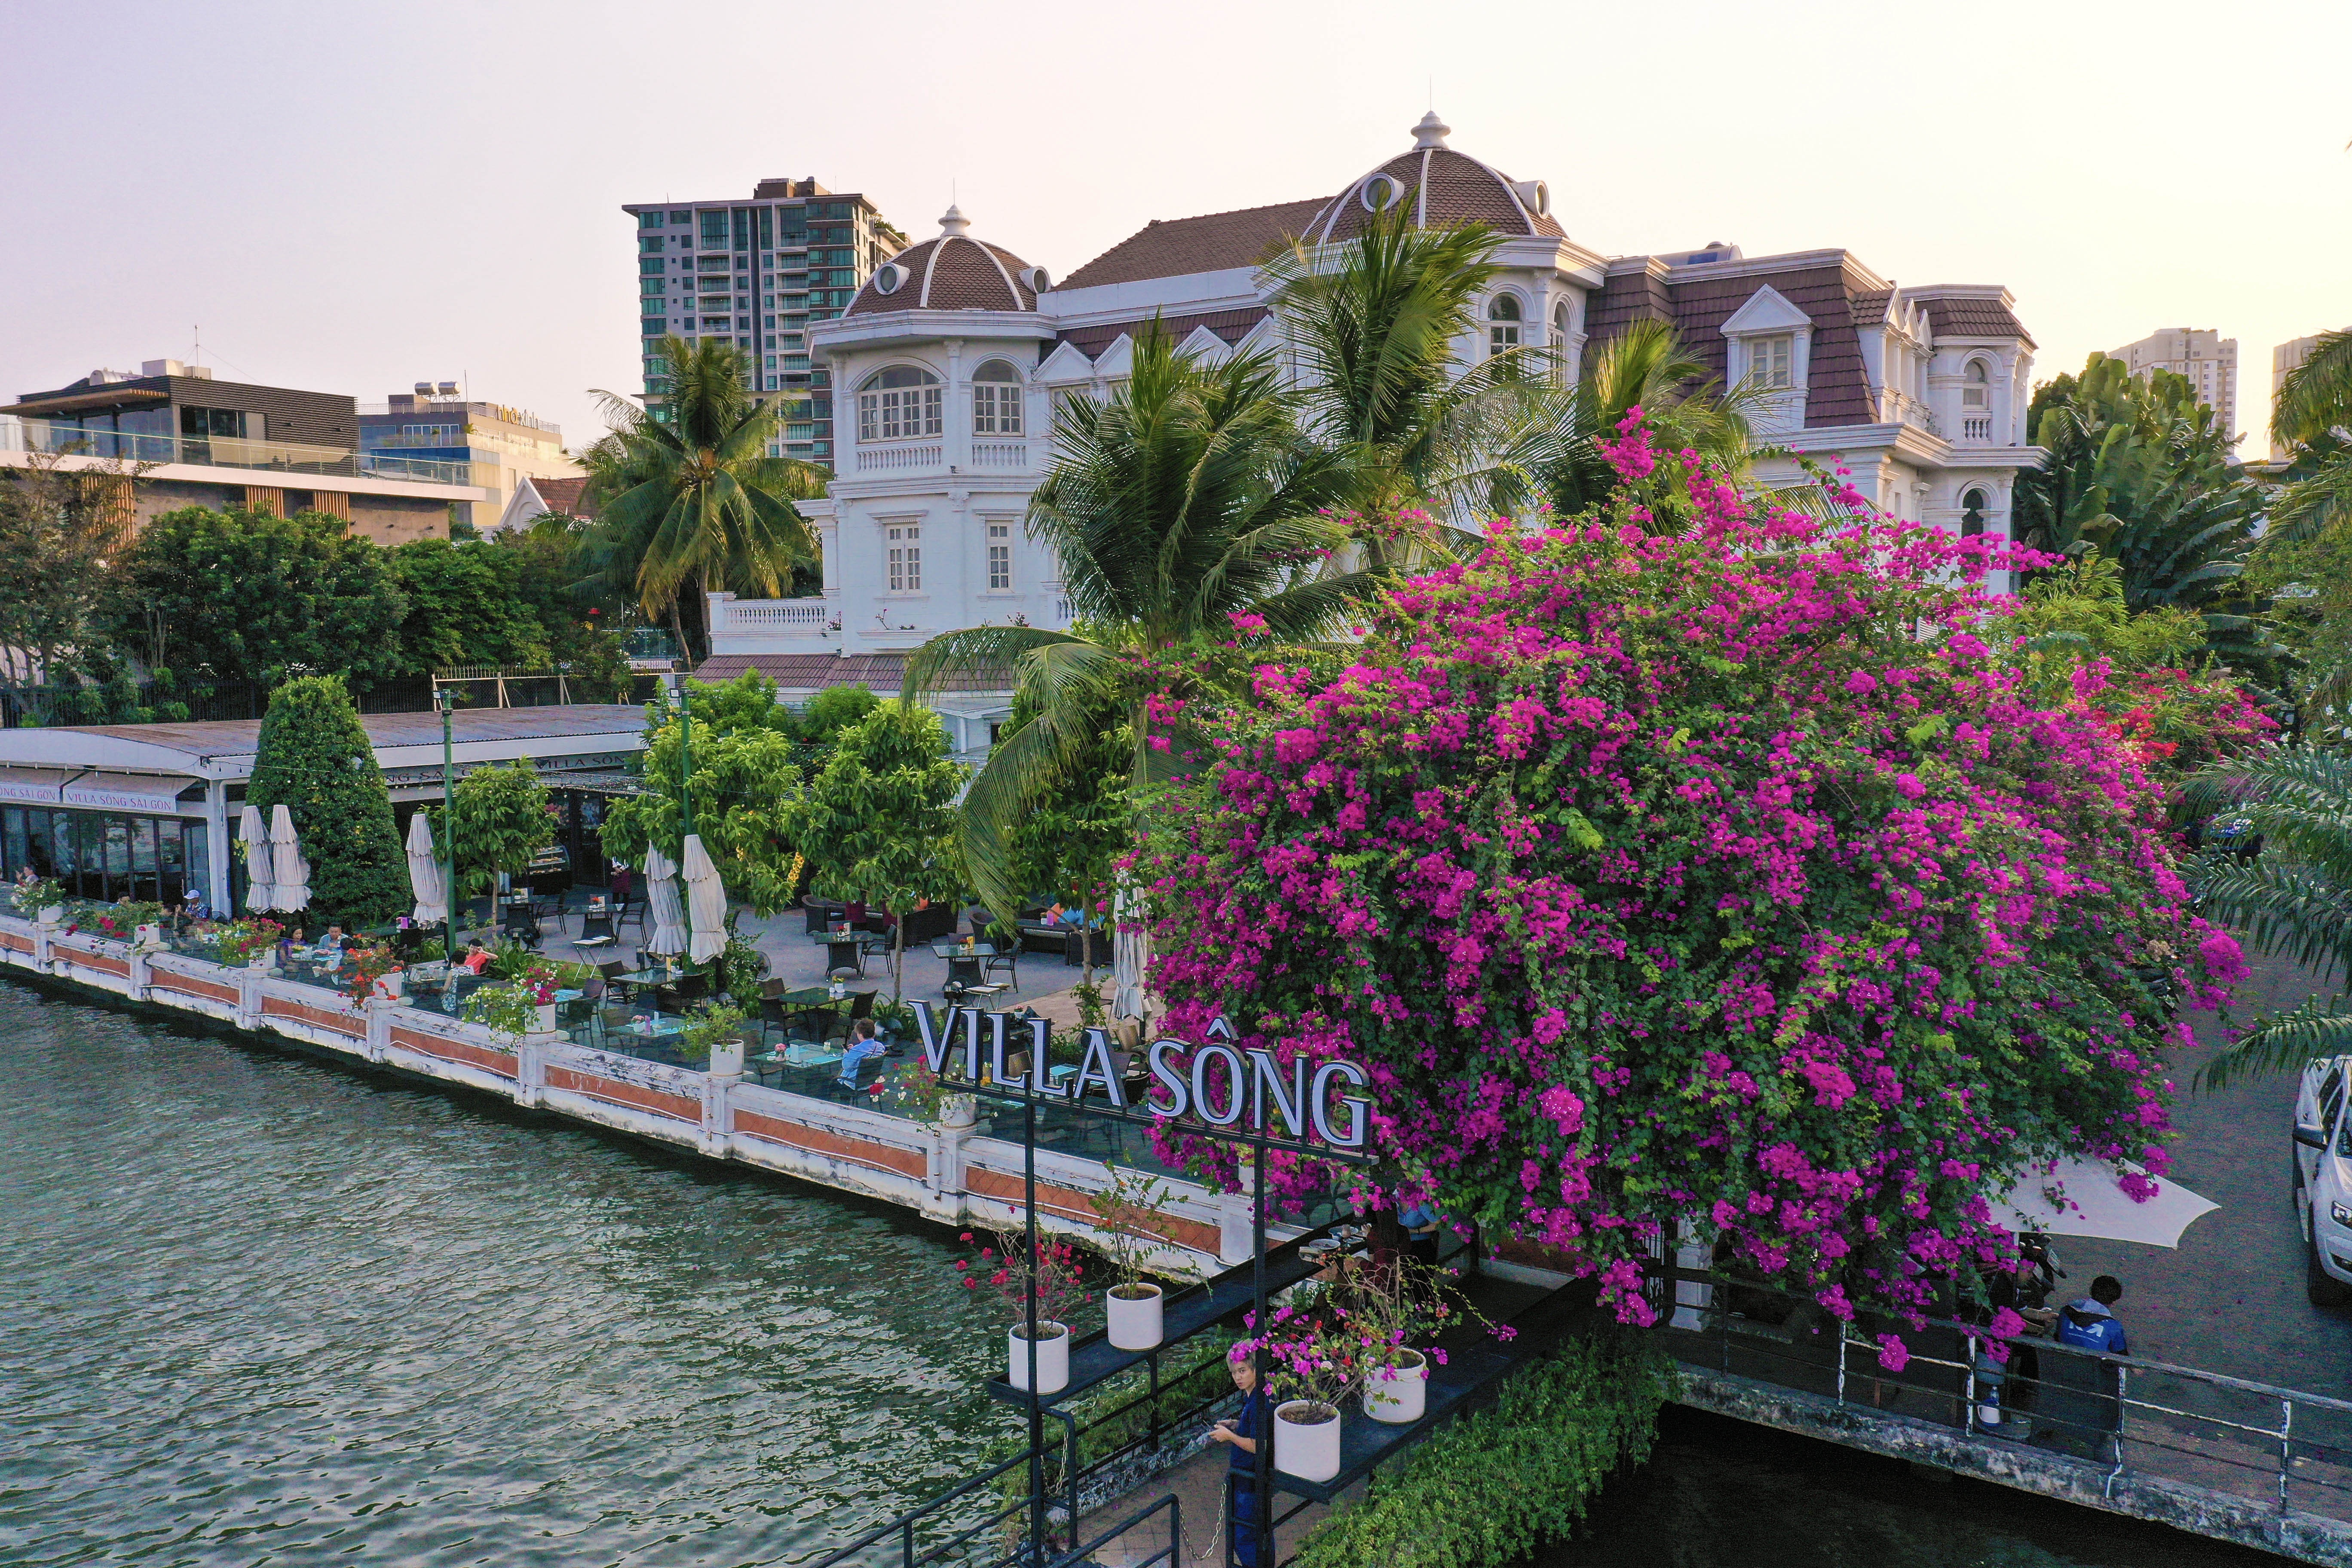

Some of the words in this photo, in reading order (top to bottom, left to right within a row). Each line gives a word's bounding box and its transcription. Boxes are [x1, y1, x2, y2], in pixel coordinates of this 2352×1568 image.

[536, 759, 585, 769] VILLA
[592, 755, 625, 765] SÔN
[68, 793, 97, 804] VILLA
[100, 794, 127, 806] SÔNG
[907, 999, 1127, 1108] VILLA
[1147, 1014, 1372, 1147] SÔNG
